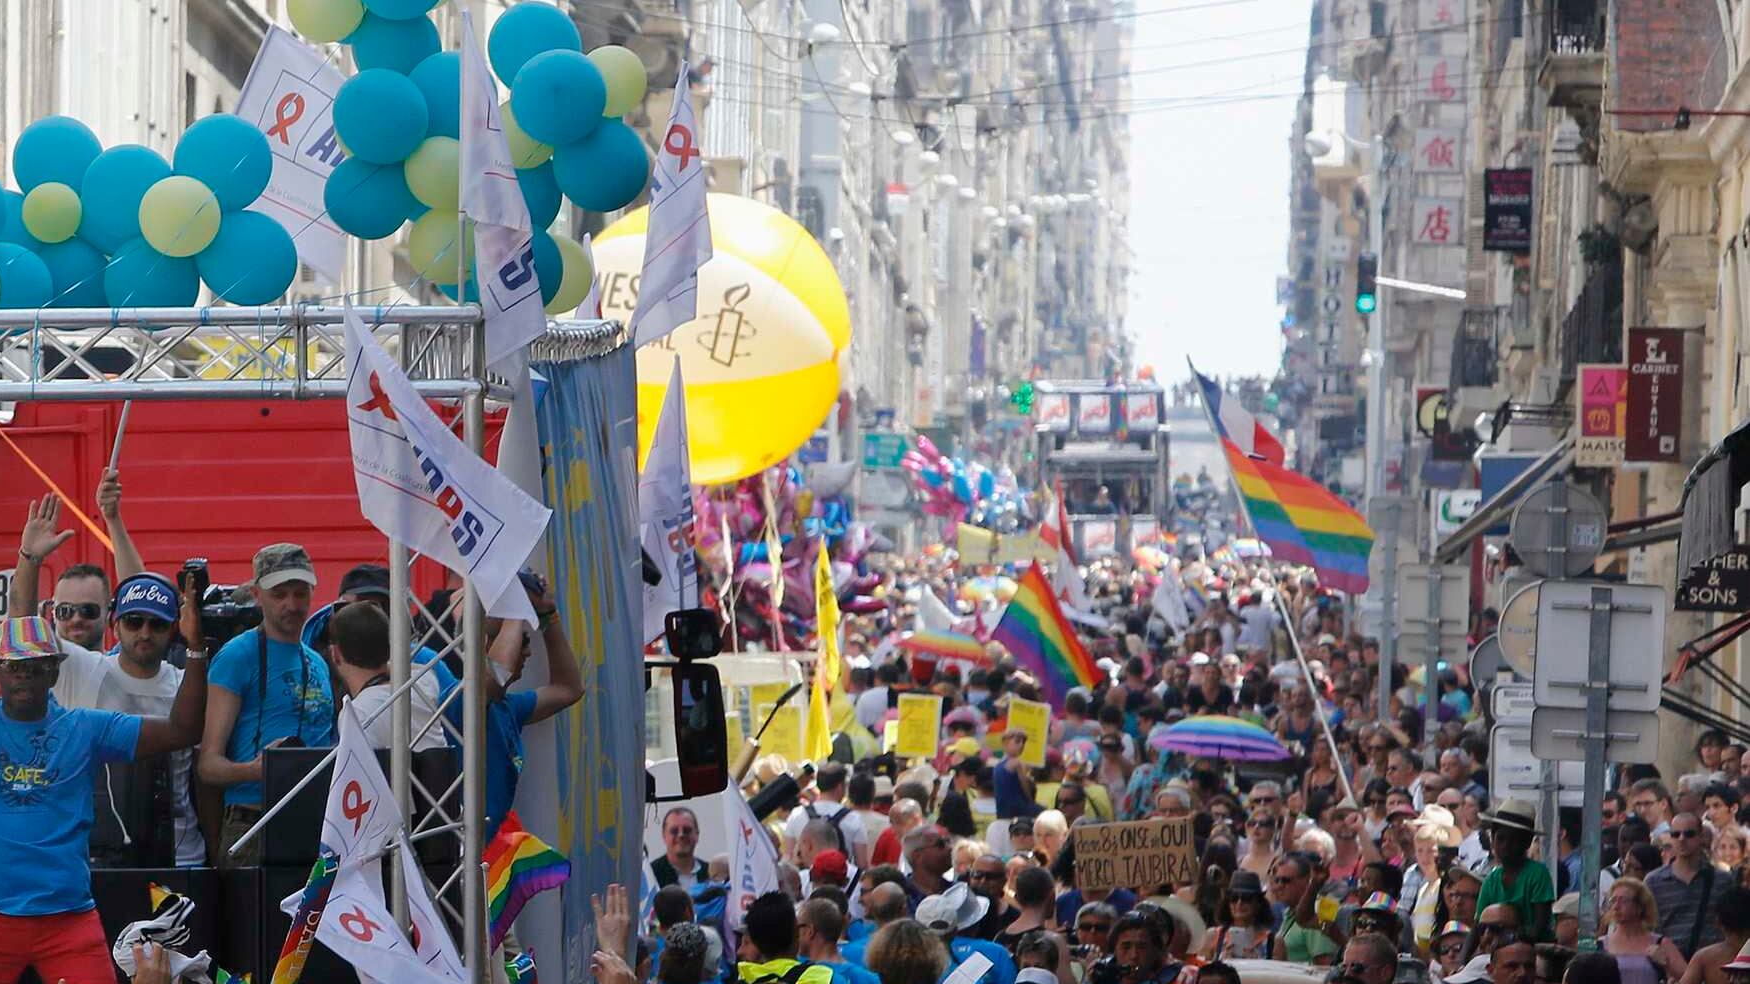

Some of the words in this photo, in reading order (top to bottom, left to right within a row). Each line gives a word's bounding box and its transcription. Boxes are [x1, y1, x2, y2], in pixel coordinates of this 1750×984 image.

[1632, 363, 1679, 374] CABINET
[1707, 569, 1721, 586] &
[121, 584, 147, 604] New
[146, 585, 169, 605] Era
[1690, 586, 1738, 605] SONS
[1077, 856, 1117, 889] MERCI
